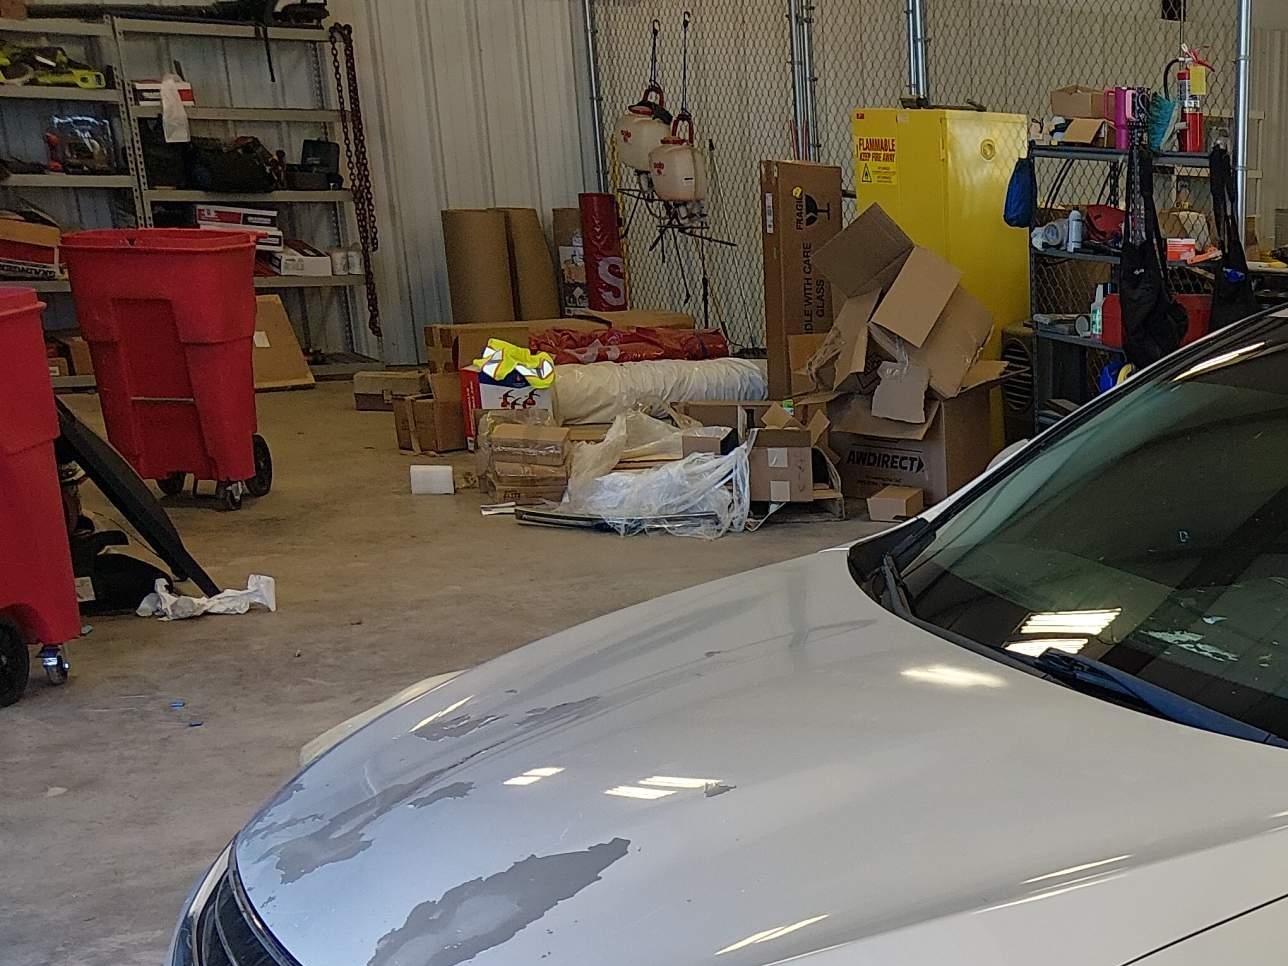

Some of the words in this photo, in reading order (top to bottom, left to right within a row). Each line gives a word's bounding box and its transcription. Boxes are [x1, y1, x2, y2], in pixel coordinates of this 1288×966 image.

[859, 138, 895, 152] FLAMMABLE
[802, 242, 812, 275] CARE
[803, 277, 813, 306] WITH
[815, 279, 825, 318] GLASS
[847, 449, 918, 473] AWDIRECT
